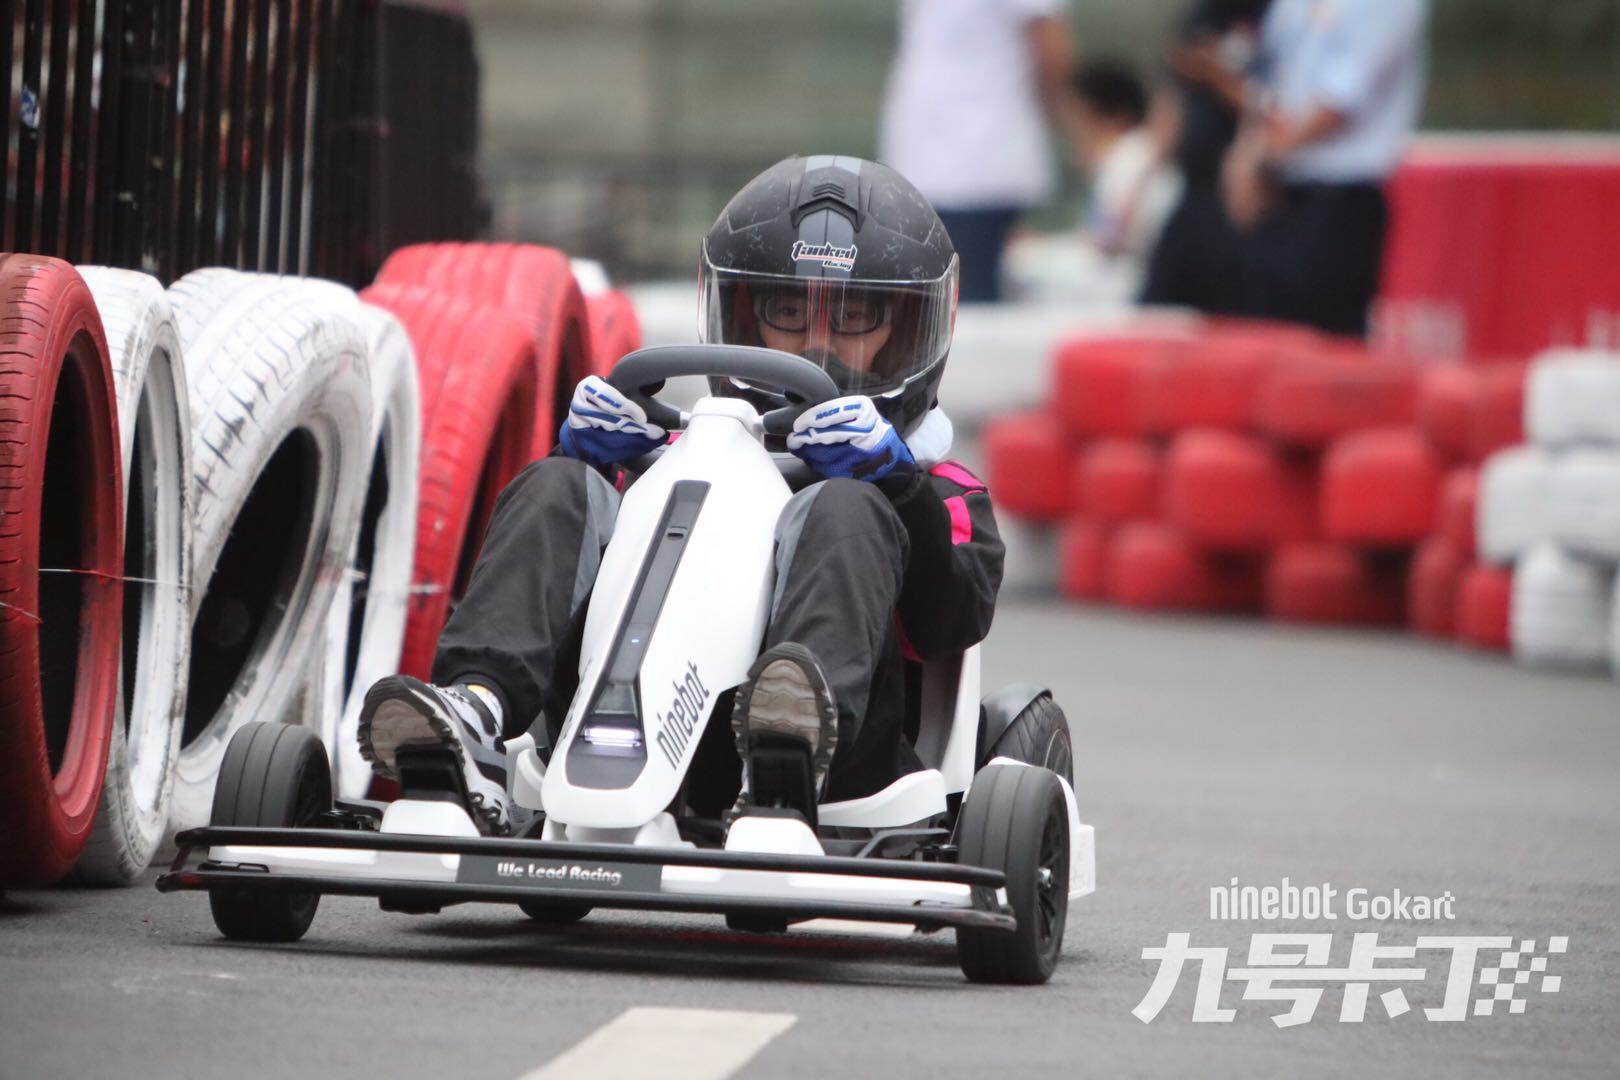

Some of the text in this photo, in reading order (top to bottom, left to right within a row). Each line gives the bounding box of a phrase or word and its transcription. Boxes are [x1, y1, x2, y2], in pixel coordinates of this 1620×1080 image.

[656, 659, 710, 771] ninebot
[497, 862, 622, 886] We Lead Racing
